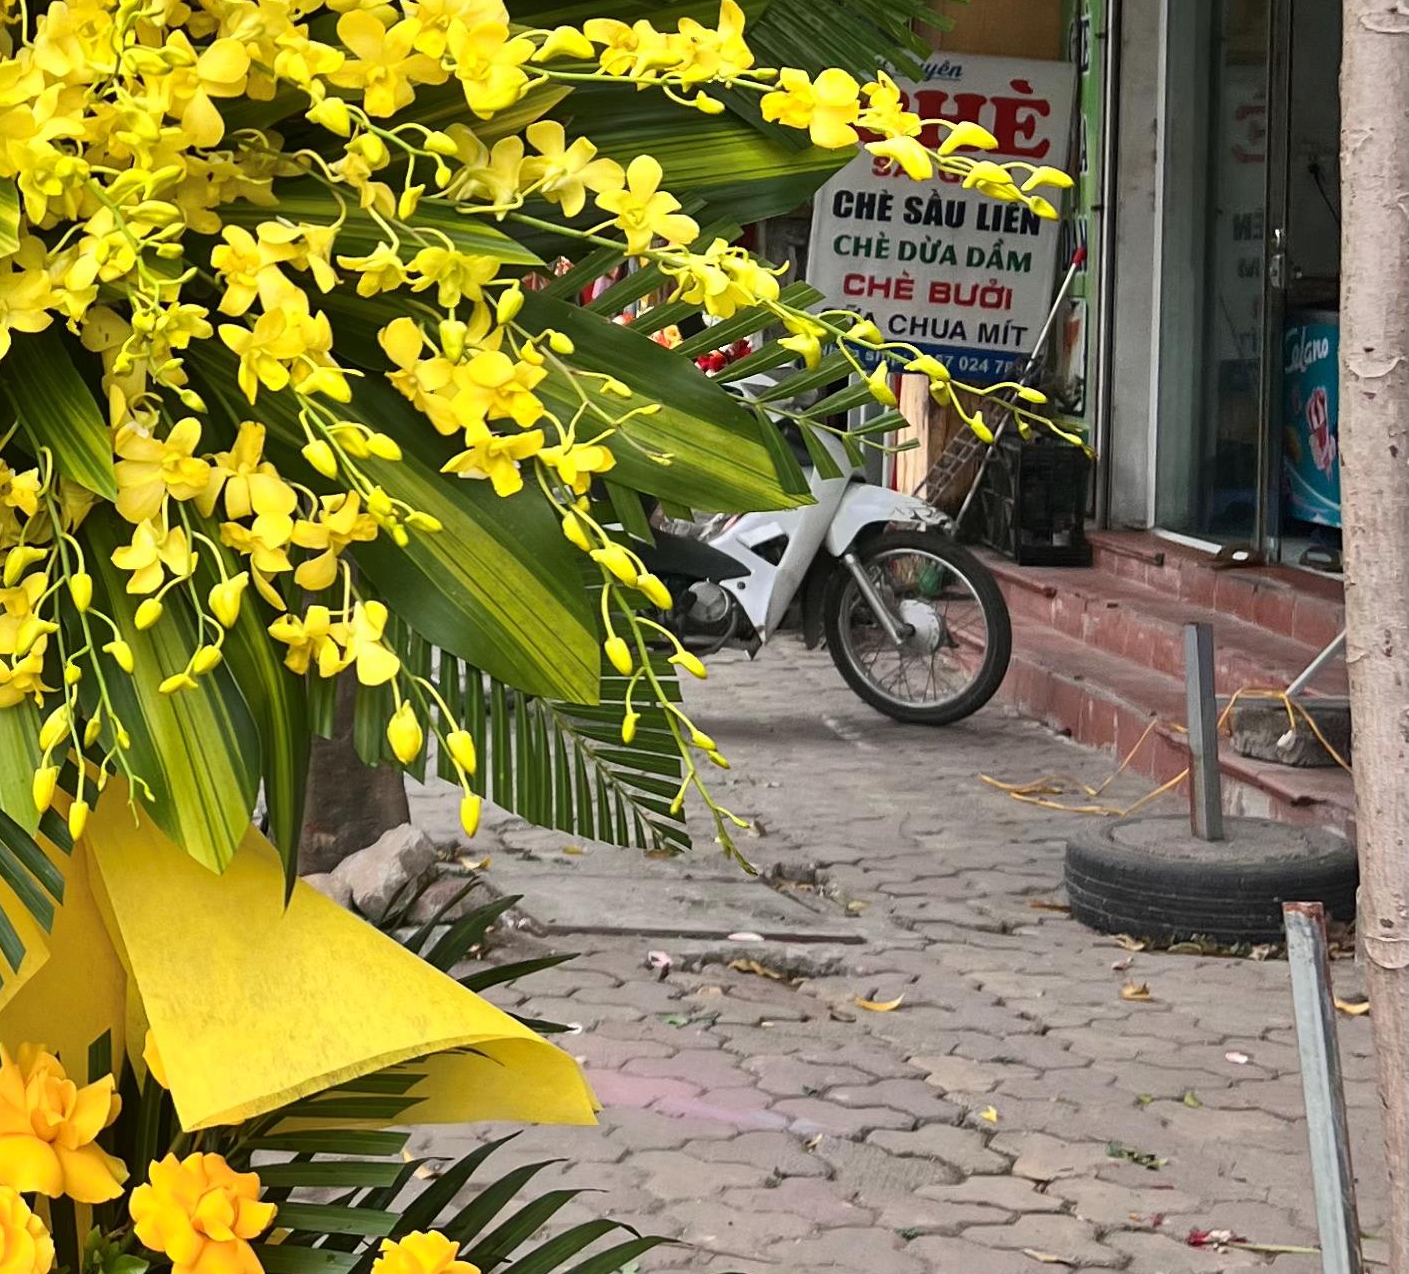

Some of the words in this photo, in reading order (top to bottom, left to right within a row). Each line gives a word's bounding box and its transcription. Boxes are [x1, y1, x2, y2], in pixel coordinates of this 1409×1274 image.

[832, 189, 894, 222] CHÈ
[902, 188, 966, 232] SẦU
[976, 200, 1041, 236] LIÊN
[833, 231, 890, 260] CHÈ
[897, 236, 958, 267] DỪA
[966, 238, 1033, 273] DẦM
[843, 270, 915, 301] CHÈ
[928, 277, 1014, 311] BƯỞI
[888, 313, 967, 341] CHUA
[977, 319, 1028, 346] MÍT
